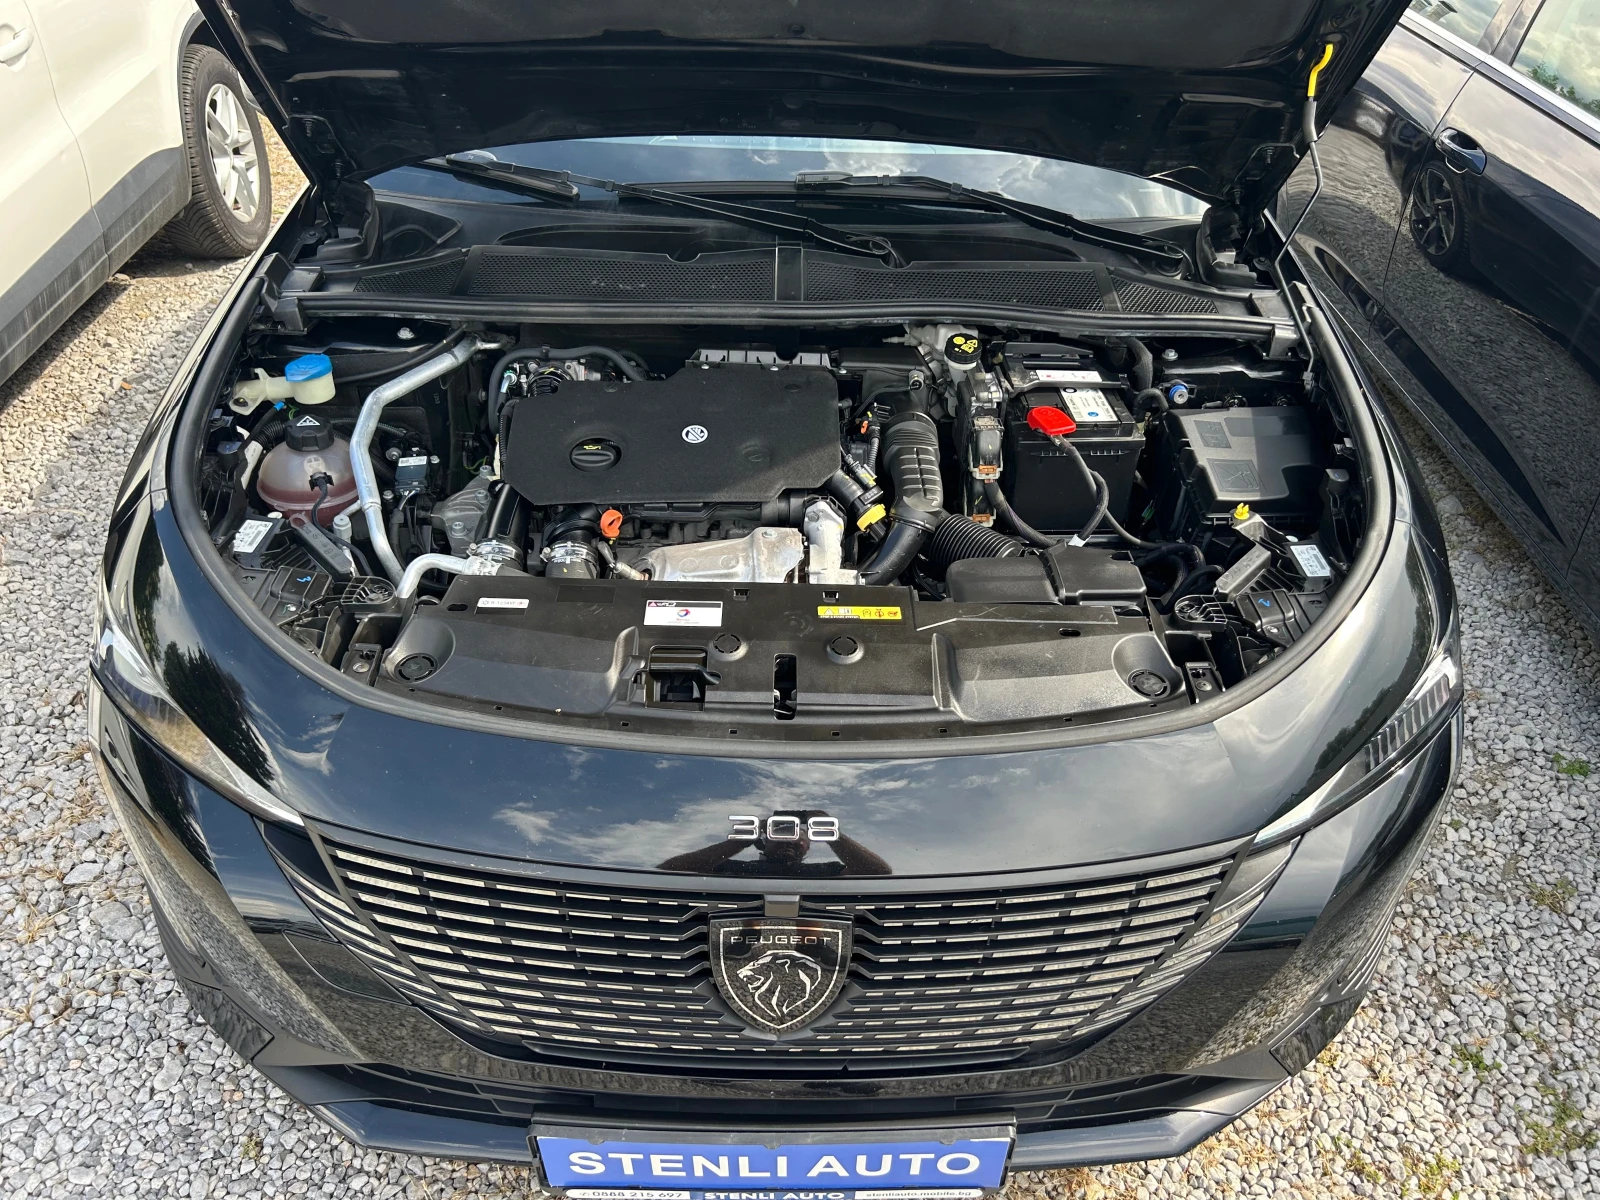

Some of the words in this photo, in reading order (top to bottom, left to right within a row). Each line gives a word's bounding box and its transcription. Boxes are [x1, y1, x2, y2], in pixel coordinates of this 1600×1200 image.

[727, 814, 840, 841] 308
[730, 934, 832, 945] PEUGEOT
[568, 1151, 788, 1177] STENLI
[806, 1152, 981, 1176] AUTO
[704, 1191, 775, 1200] STENLI
[782, 1191, 845, 1200] AUTO
